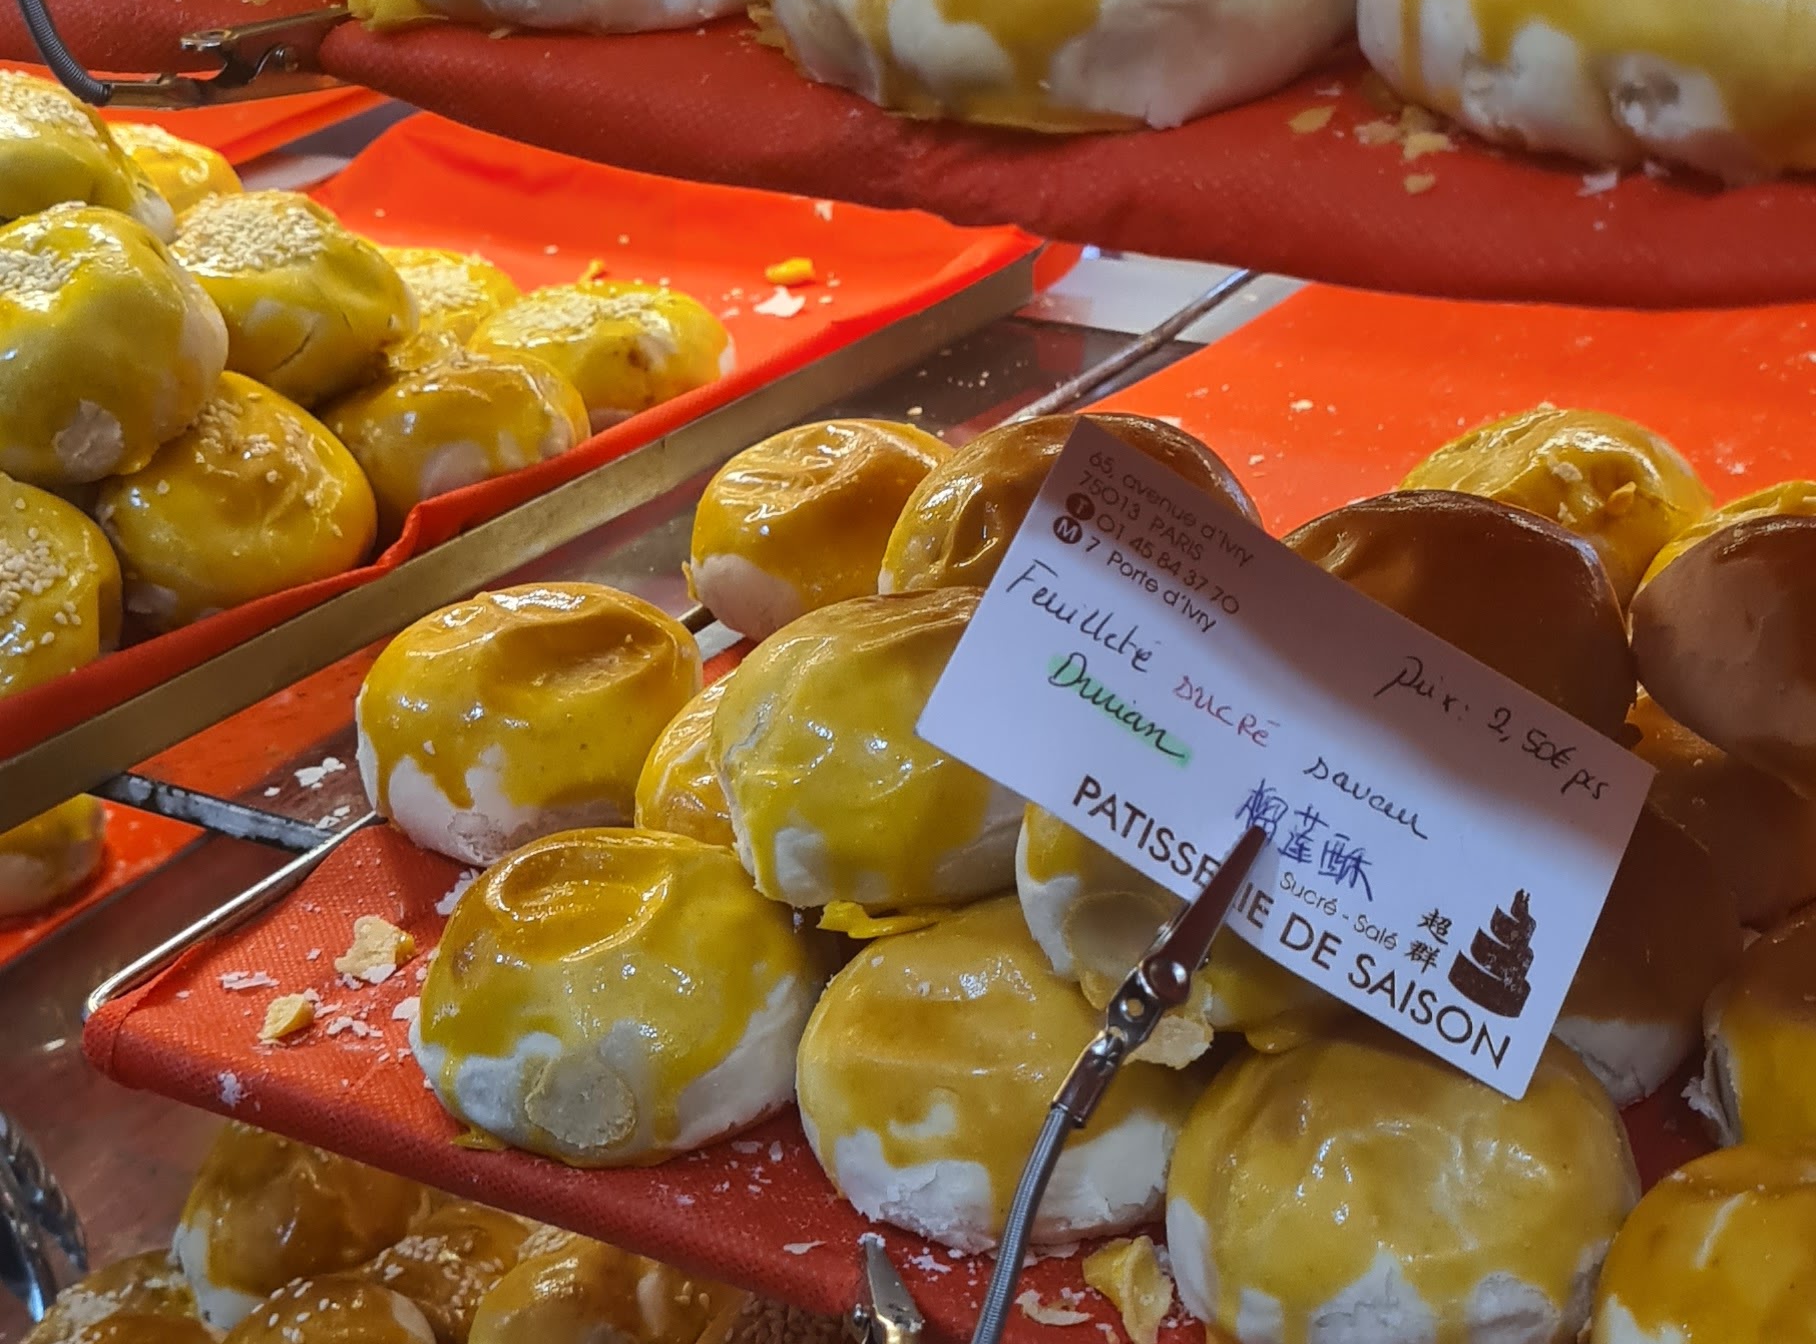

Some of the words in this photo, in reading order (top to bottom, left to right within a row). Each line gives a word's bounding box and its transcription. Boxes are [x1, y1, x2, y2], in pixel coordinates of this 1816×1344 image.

[1079, 470, 1140, 520] 75013
[1150, 517, 1204, 560] PARIS
[1089, 452, 1115, 478] 65,
[1123, 474, 1197, 527] avenue
[1201, 524, 1254, 567] d'Ivry
[1006, 558, 1162, 673] Feuilleté
[1085, 536, 1101, 553] 7
[1107, 550, 1158, 593] Porte
[1163, 589, 1217, 634] d'Ivry
[1097, 514, 1125, 541] 01
[1129, 536, 1155, 559] 45
[1157, 552, 1182, 577] 84
[1183, 569, 1209, 591] 37
[1210, 585, 1240, 614] 70
[1048, 651, 1186, 759] Durian
[1072, 774, 1274, 929] PATISSEIE
[1280, 912, 1342, 970] DE
[1348, 953, 1511, 1070] SAISON
[1280, 871, 1337, 916] Sucré
[1354, 914, 1399, 951] Salé
